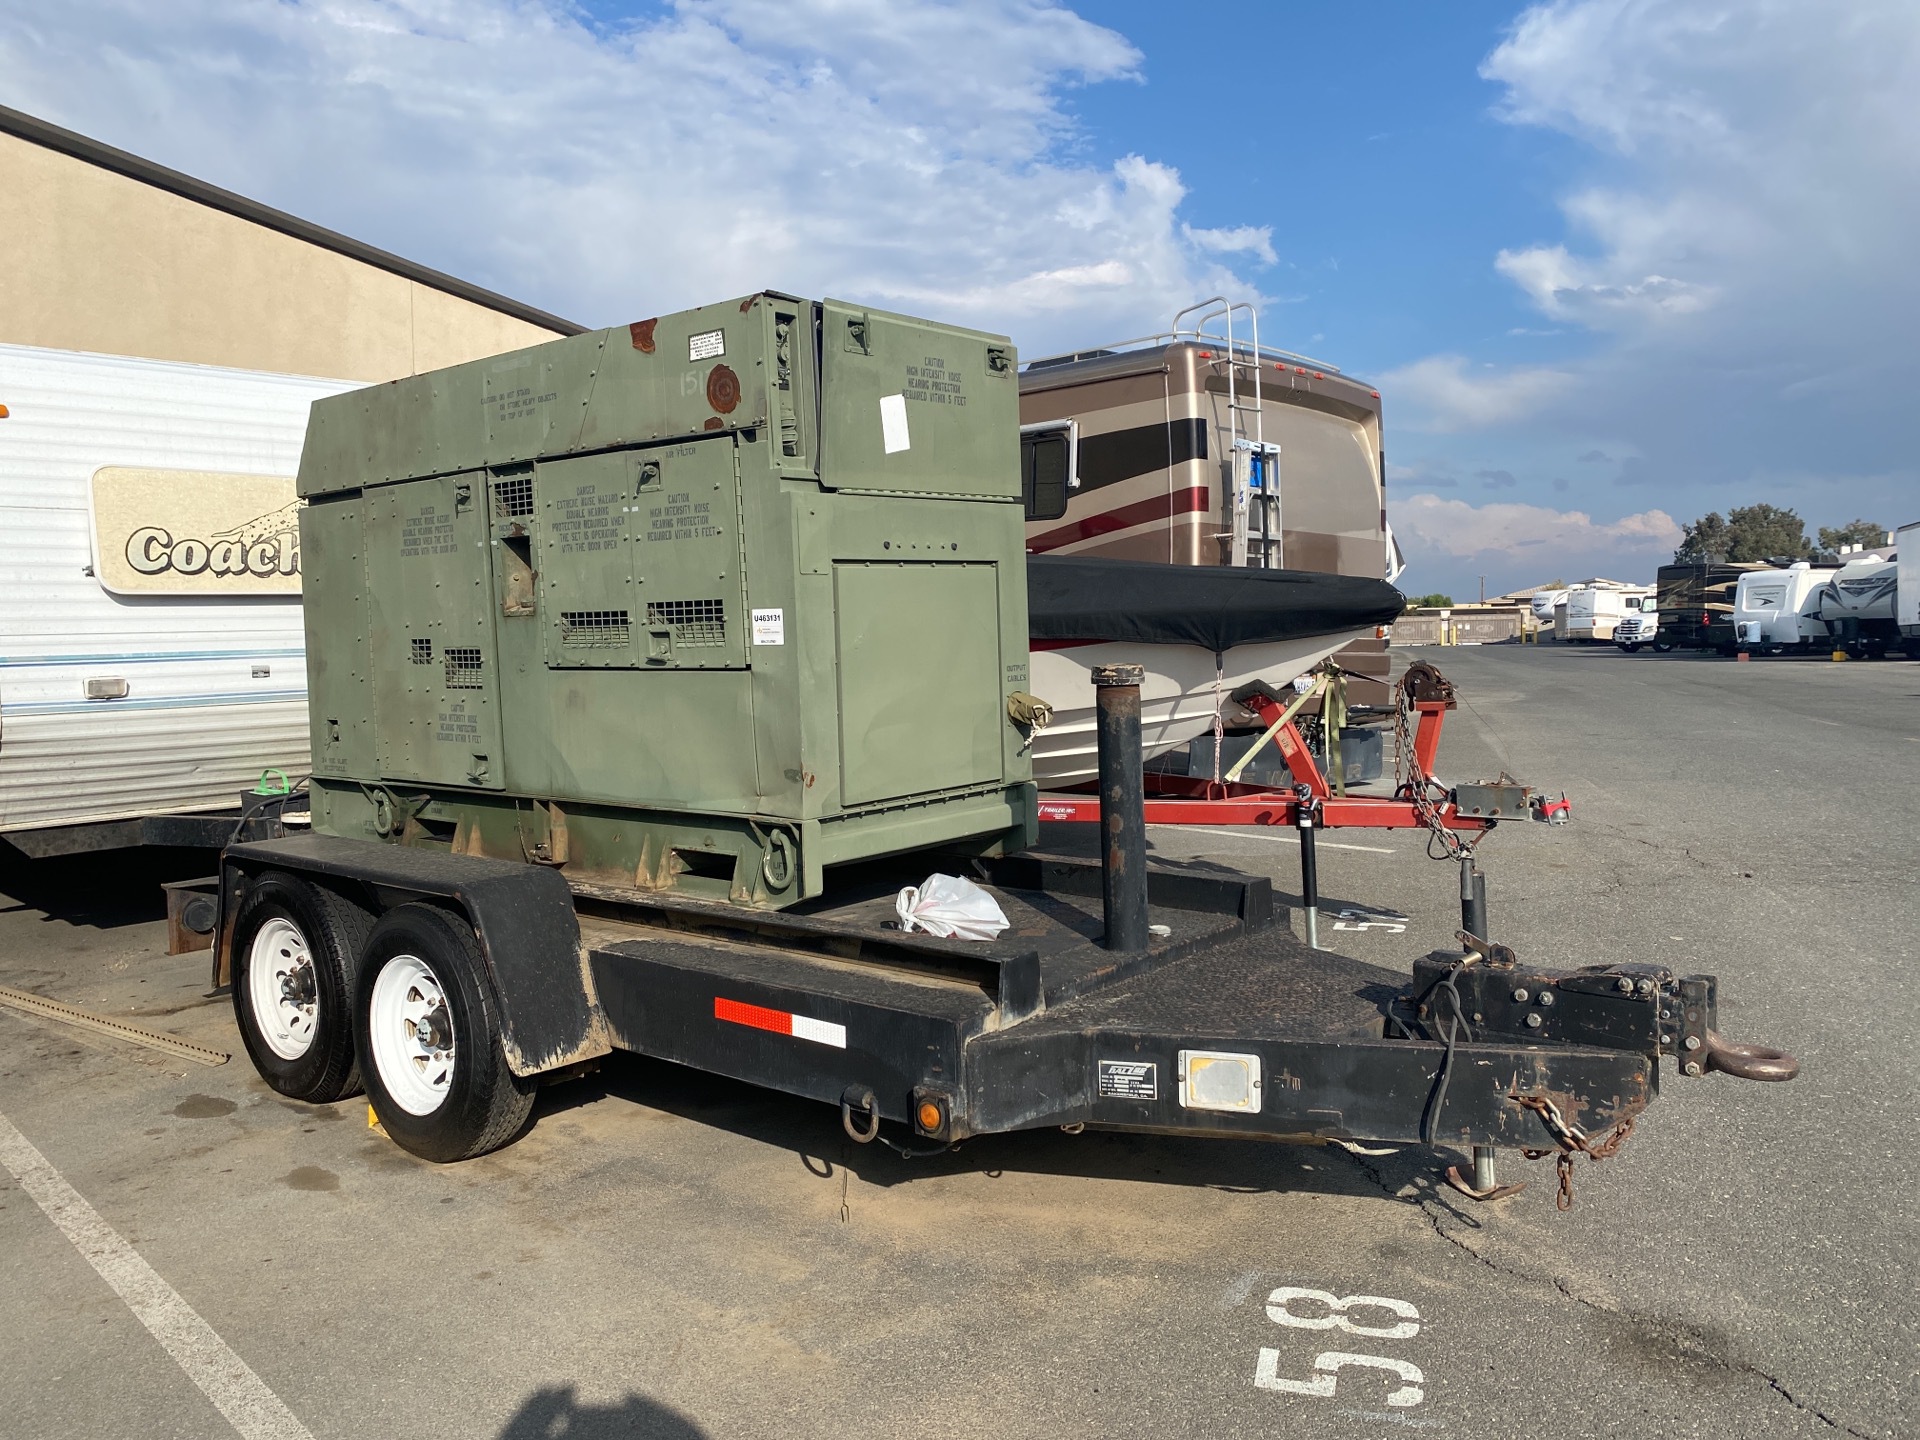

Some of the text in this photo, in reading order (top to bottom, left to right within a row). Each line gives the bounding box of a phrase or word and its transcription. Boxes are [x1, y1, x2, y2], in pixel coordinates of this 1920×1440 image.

[925, 356, 945, 370] CAUTION
[906, 365, 962, 383] HIGH INTENSITY NOISE
[908, 377, 961, 394] HEARING PROTECTION
[902, 389, 928, 402] REQUIRED
[929, 392, 946, 404] WITHIN
[953, 395, 967, 407] FEET
[556, 498, 579, 510] EXTREME
[668, 493, 690, 505] CAUTION
[649, 502, 710, 518] HIGH INTENSITY NOISE
[551, 521, 582, 532] PROTECTION
[583, 518, 609, 530] REQUIRED
[651, 515, 710, 530] HEARING PROTECTION
[647, 526, 716, 542] REQUIRED WITHIN 5 FEET
[754, 614, 781, 622] U463131
[1007, 664, 1026, 672] OUTPUT
[1254, 1286, 1424, 1407] 58
